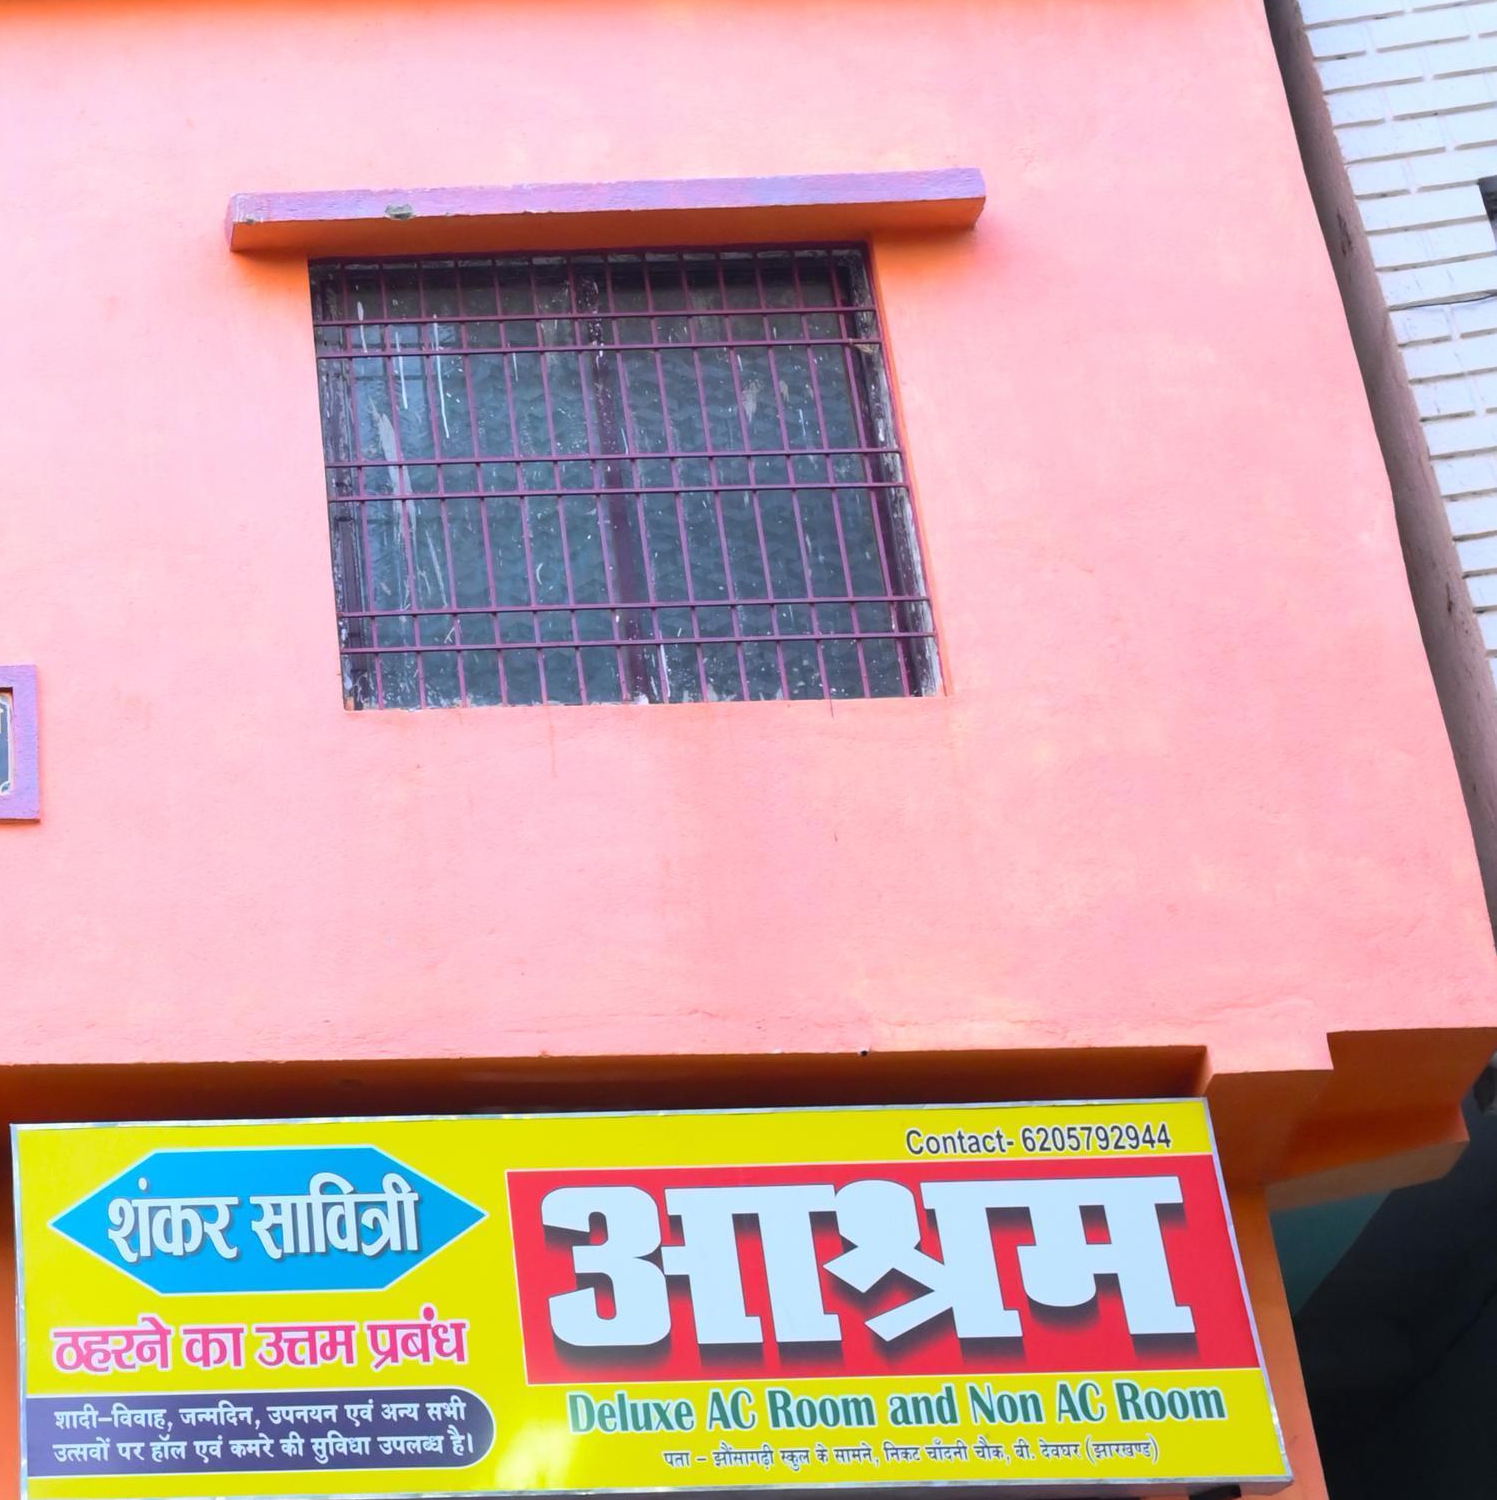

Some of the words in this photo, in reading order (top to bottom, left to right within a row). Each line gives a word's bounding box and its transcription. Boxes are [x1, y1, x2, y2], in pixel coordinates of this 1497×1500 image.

[905, 1129, 1014, 1155] Contact-
[1021, 1123, 1171, 1152] 6205792944
[107, 1177, 239, 1262] शंकर
[249, 1172, 421, 1260] सावित्री
[541, 1175, 1196, 1348] आश्रम
[52, 1316, 171, 1371] ठहरने
[183, 1327, 245, 1368] का
[255, 1324, 356, 1367] उत्तम
[367, 1307, 467, 1370] प्रबंध
[179, 1400, 260, 1429] जन्मदिन,
[266, 1404, 338, 1424] उपनयन
[344, 1399, 374, 1427] एवं
[381, 1403, 420, 1421] अन्य
[426, 1395, 467, 1421] सभी
[566, 1391, 696, 1434] Deluxe
[707, 1389, 757, 1430] AC
[766, 1388, 877, 1429] Room
[889, 1384, 959, 1425] and
[967, 1383, 1045, 1424] Non
[1057, 1381, 1105, 1422] AC
[1113, 1380, 1228, 1421] Room
[52, 1437, 111, 1463] उत्सवों
[117, 1443, 145, 1460] पर
[150, 1434, 187, 1463] हॉल
[193, 1435, 223, 1463] एवं
[229, 1433, 275, 1458] कमरे
[279, 1431, 305, 1457] की
[311, 1429, 371, 1464] सुविधा
[377, 1435, 444, 1455] उपलब्ध
[663, 1450, 690, 1468] पता
[815, 1443, 828, 1463] के
[834, 1442, 880, 1467] सामने,
[884, 1440, 920, 1463] निकट
[924, 1439, 968, 1462] चाँदनी
[972, 1436, 1011, 1465] चौक,
[1040, 1438, 1080, 1460] देवघर
[1085, 1433, 1160, 1464] (झारखण्ड)
